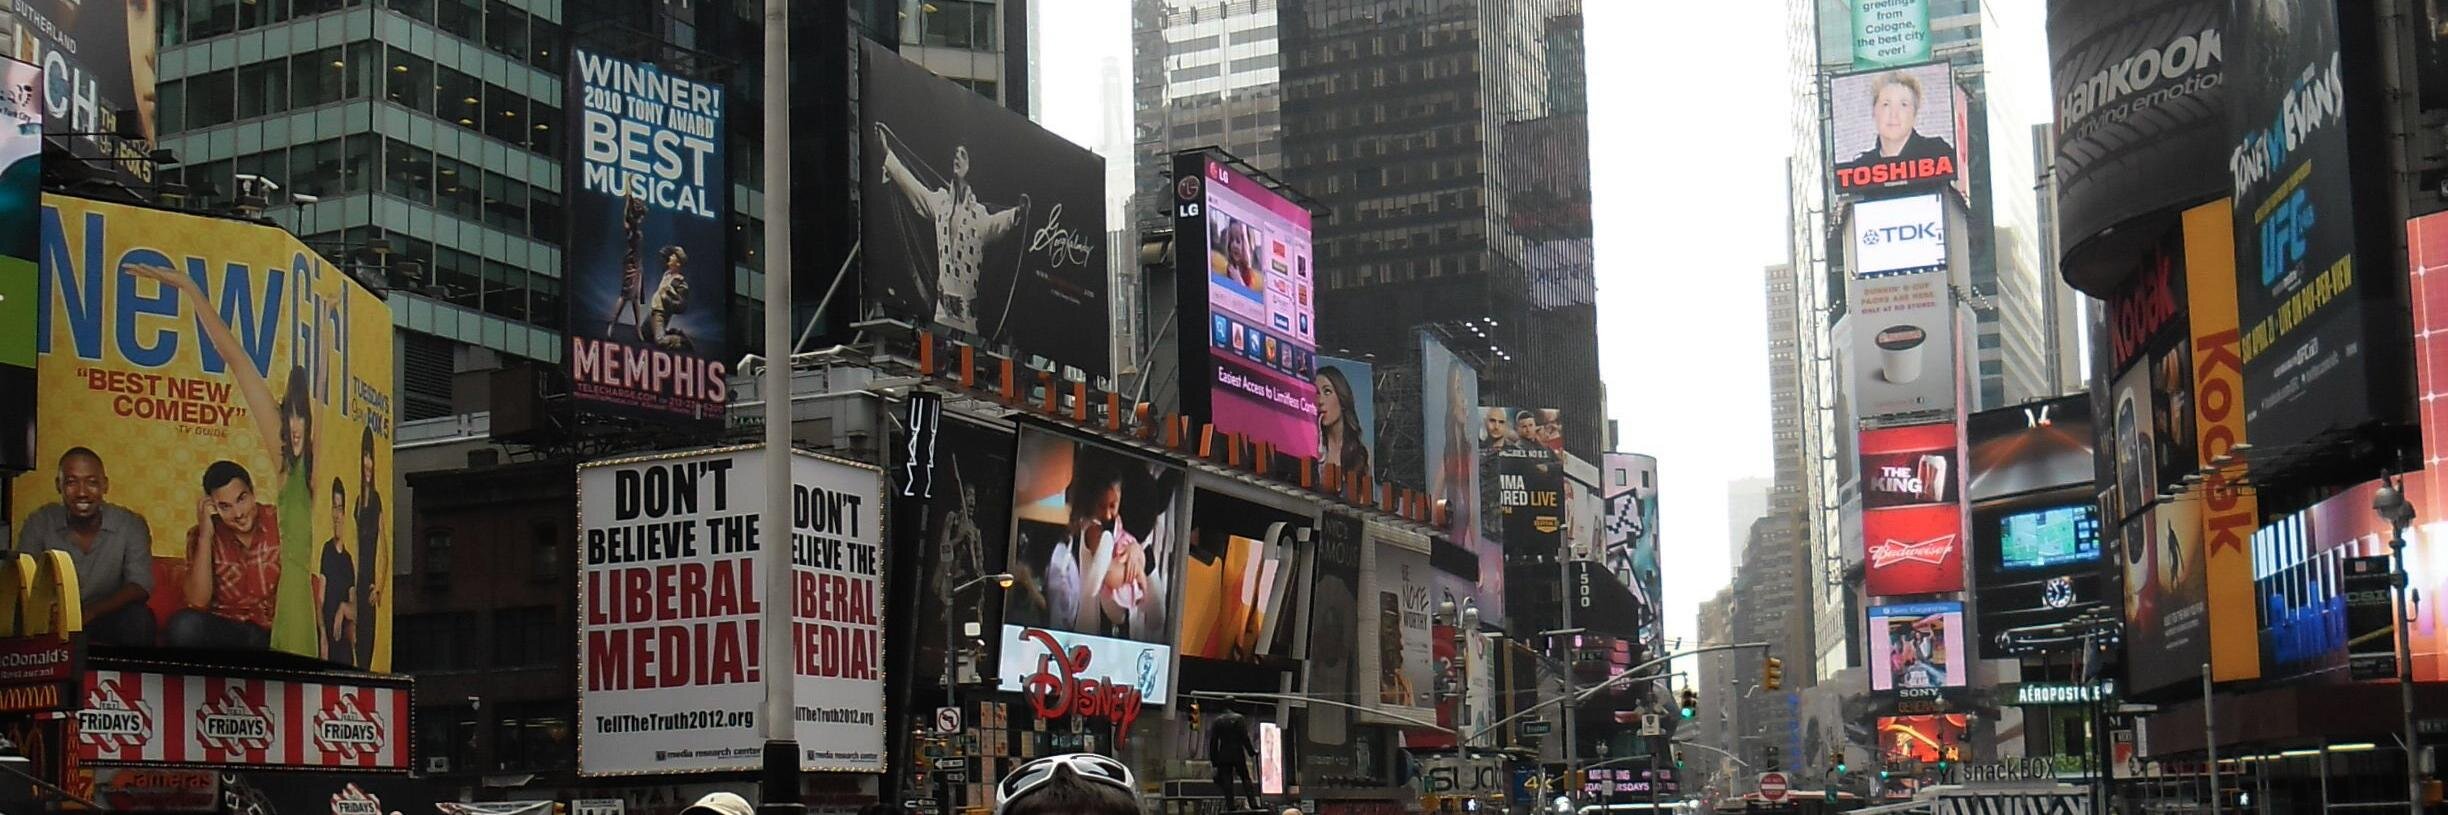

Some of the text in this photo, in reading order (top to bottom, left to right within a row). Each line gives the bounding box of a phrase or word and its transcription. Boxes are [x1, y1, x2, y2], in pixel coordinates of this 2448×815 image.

[14, 0, 77, 54] SUTHERLAND
[1865, 20, 1917, 35] Cologne,
[1877, 10, 1903, 20] from
[1857, 30, 1926, 48] the best city
[1878, 45, 1907, 57] ever!
[577, 50, 721, 118] WINNER!
[584, 85, 715, 139] 2010 TONY AWARD
[2076, 102, 2129, 142] driving
[584, 109, 715, 187] BEST
[584, 160, 716, 218] MUSICAL
[1218, 167, 1230, 185] LG
[1836, 155, 1954, 188] TOSHIBA
[1179, 203, 1200, 218] LG
[1879, 221, 1937, 244] TDK
[2260, 188, 2308, 288] UFC
[38, 203, 350, 416] New Girl
[2111, 256, 2176, 370] Kodak
[168, 376, 232, 404] NEW
[572, 335, 727, 403] MEMPHIS
[1218, 365, 1242, 388] Easiest
[1242, 375, 1266, 397] Access
[1265, 384, 1274, 400] to
[2196, 327, 2252, 558] Kodak
[614, 458, 733, 522] DON'T
[1870, 477, 1923, 494] KING
[1881, 466, 1912, 478] THE
[793, 483, 862, 538] DON'T
[1530, 491, 1558, 508] LIVE
[587, 513, 761, 565] BELIEVE THE
[792, 532, 877, 576] ELIEVE THE
[587, 557, 761, 626] LIBERAL
[792, 569, 877, 626] IBERAL
[1579, 561, 1590, 609] 1500
[1, 648, 69, 667] cDonald's
[587, 618, 761, 693] MEDIA!
[1018, 628, 1143, 751] Disney
[1899, 688, 1939, 698] SONY
[2018, 683, 2101, 703] AÉROPOSTAE
[596, 710, 754, 734] TellTheTruth2012.org
[667, 747, 761, 760] media research center
